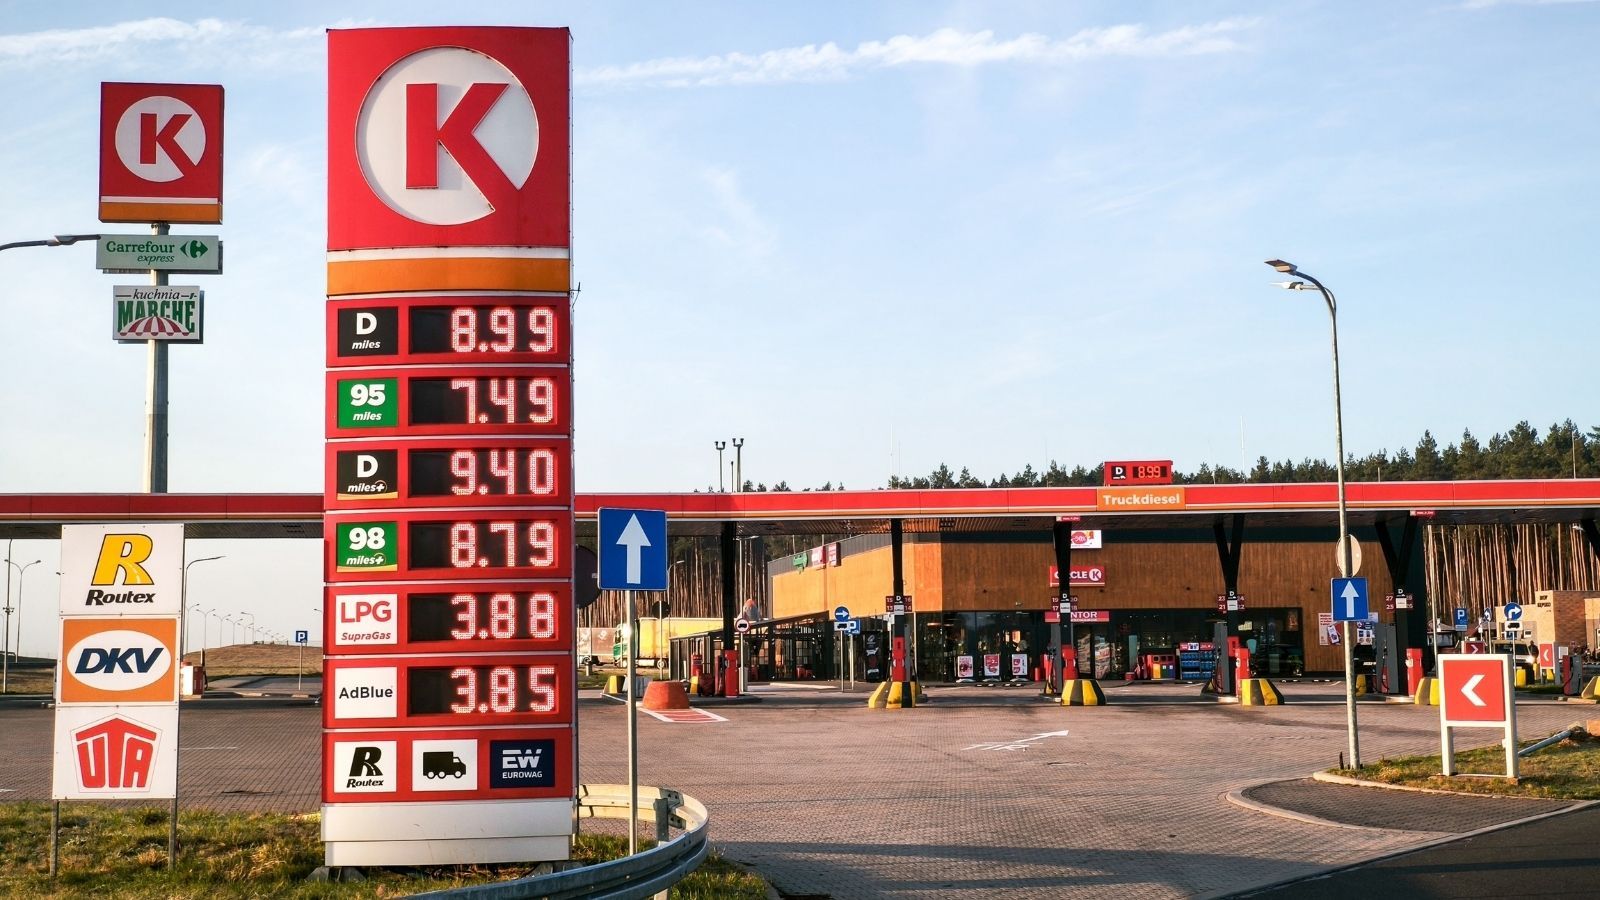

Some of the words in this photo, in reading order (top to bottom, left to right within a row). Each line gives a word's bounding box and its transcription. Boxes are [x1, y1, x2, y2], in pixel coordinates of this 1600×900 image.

[139, 112, 197, 177] K
[405, 82, 520, 211] K
[105, 240, 175, 253] Carrefour
[136, 253, 175, 266] express
[132, 287, 180, 300] kuchnia
[356, 312, 378, 335] D
[451, 307, 554, 353] 8.99
[351, 340, 381, 350] miles
[350, 383, 386, 407] 95
[450, 378, 554, 424] 7.49
[352, 411, 382, 421] miles
[357, 454, 379, 478] D
[450, 450, 554, 496] 9.40
[1115, 466, 1123, 475] D
[1138, 466, 1161, 478] 8.99
[1103, 493, 1180, 505] Truckdiesel
[349, 527, 386, 550] 98
[450, 521, 554, 568] 8.79
[1054, 571, 1088, 579] CCLE
[85, 589, 156, 606] Routex
[340, 600, 392, 624] LPG
[450, 593, 555, 640] 3.88
[1056, 611, 1097, 619] KNTOR
[341, 630, 392, 643] SupraGas
[74, 647, 164, 674] DKV
[339, 686, 394, 699] AdBlue
[450, 666, 555, 714] 3.85
[75, 717, 157, 788] UTA
[346, 778, 384, 788] Routex
[502, 771, 543, 779] EUROWAG
